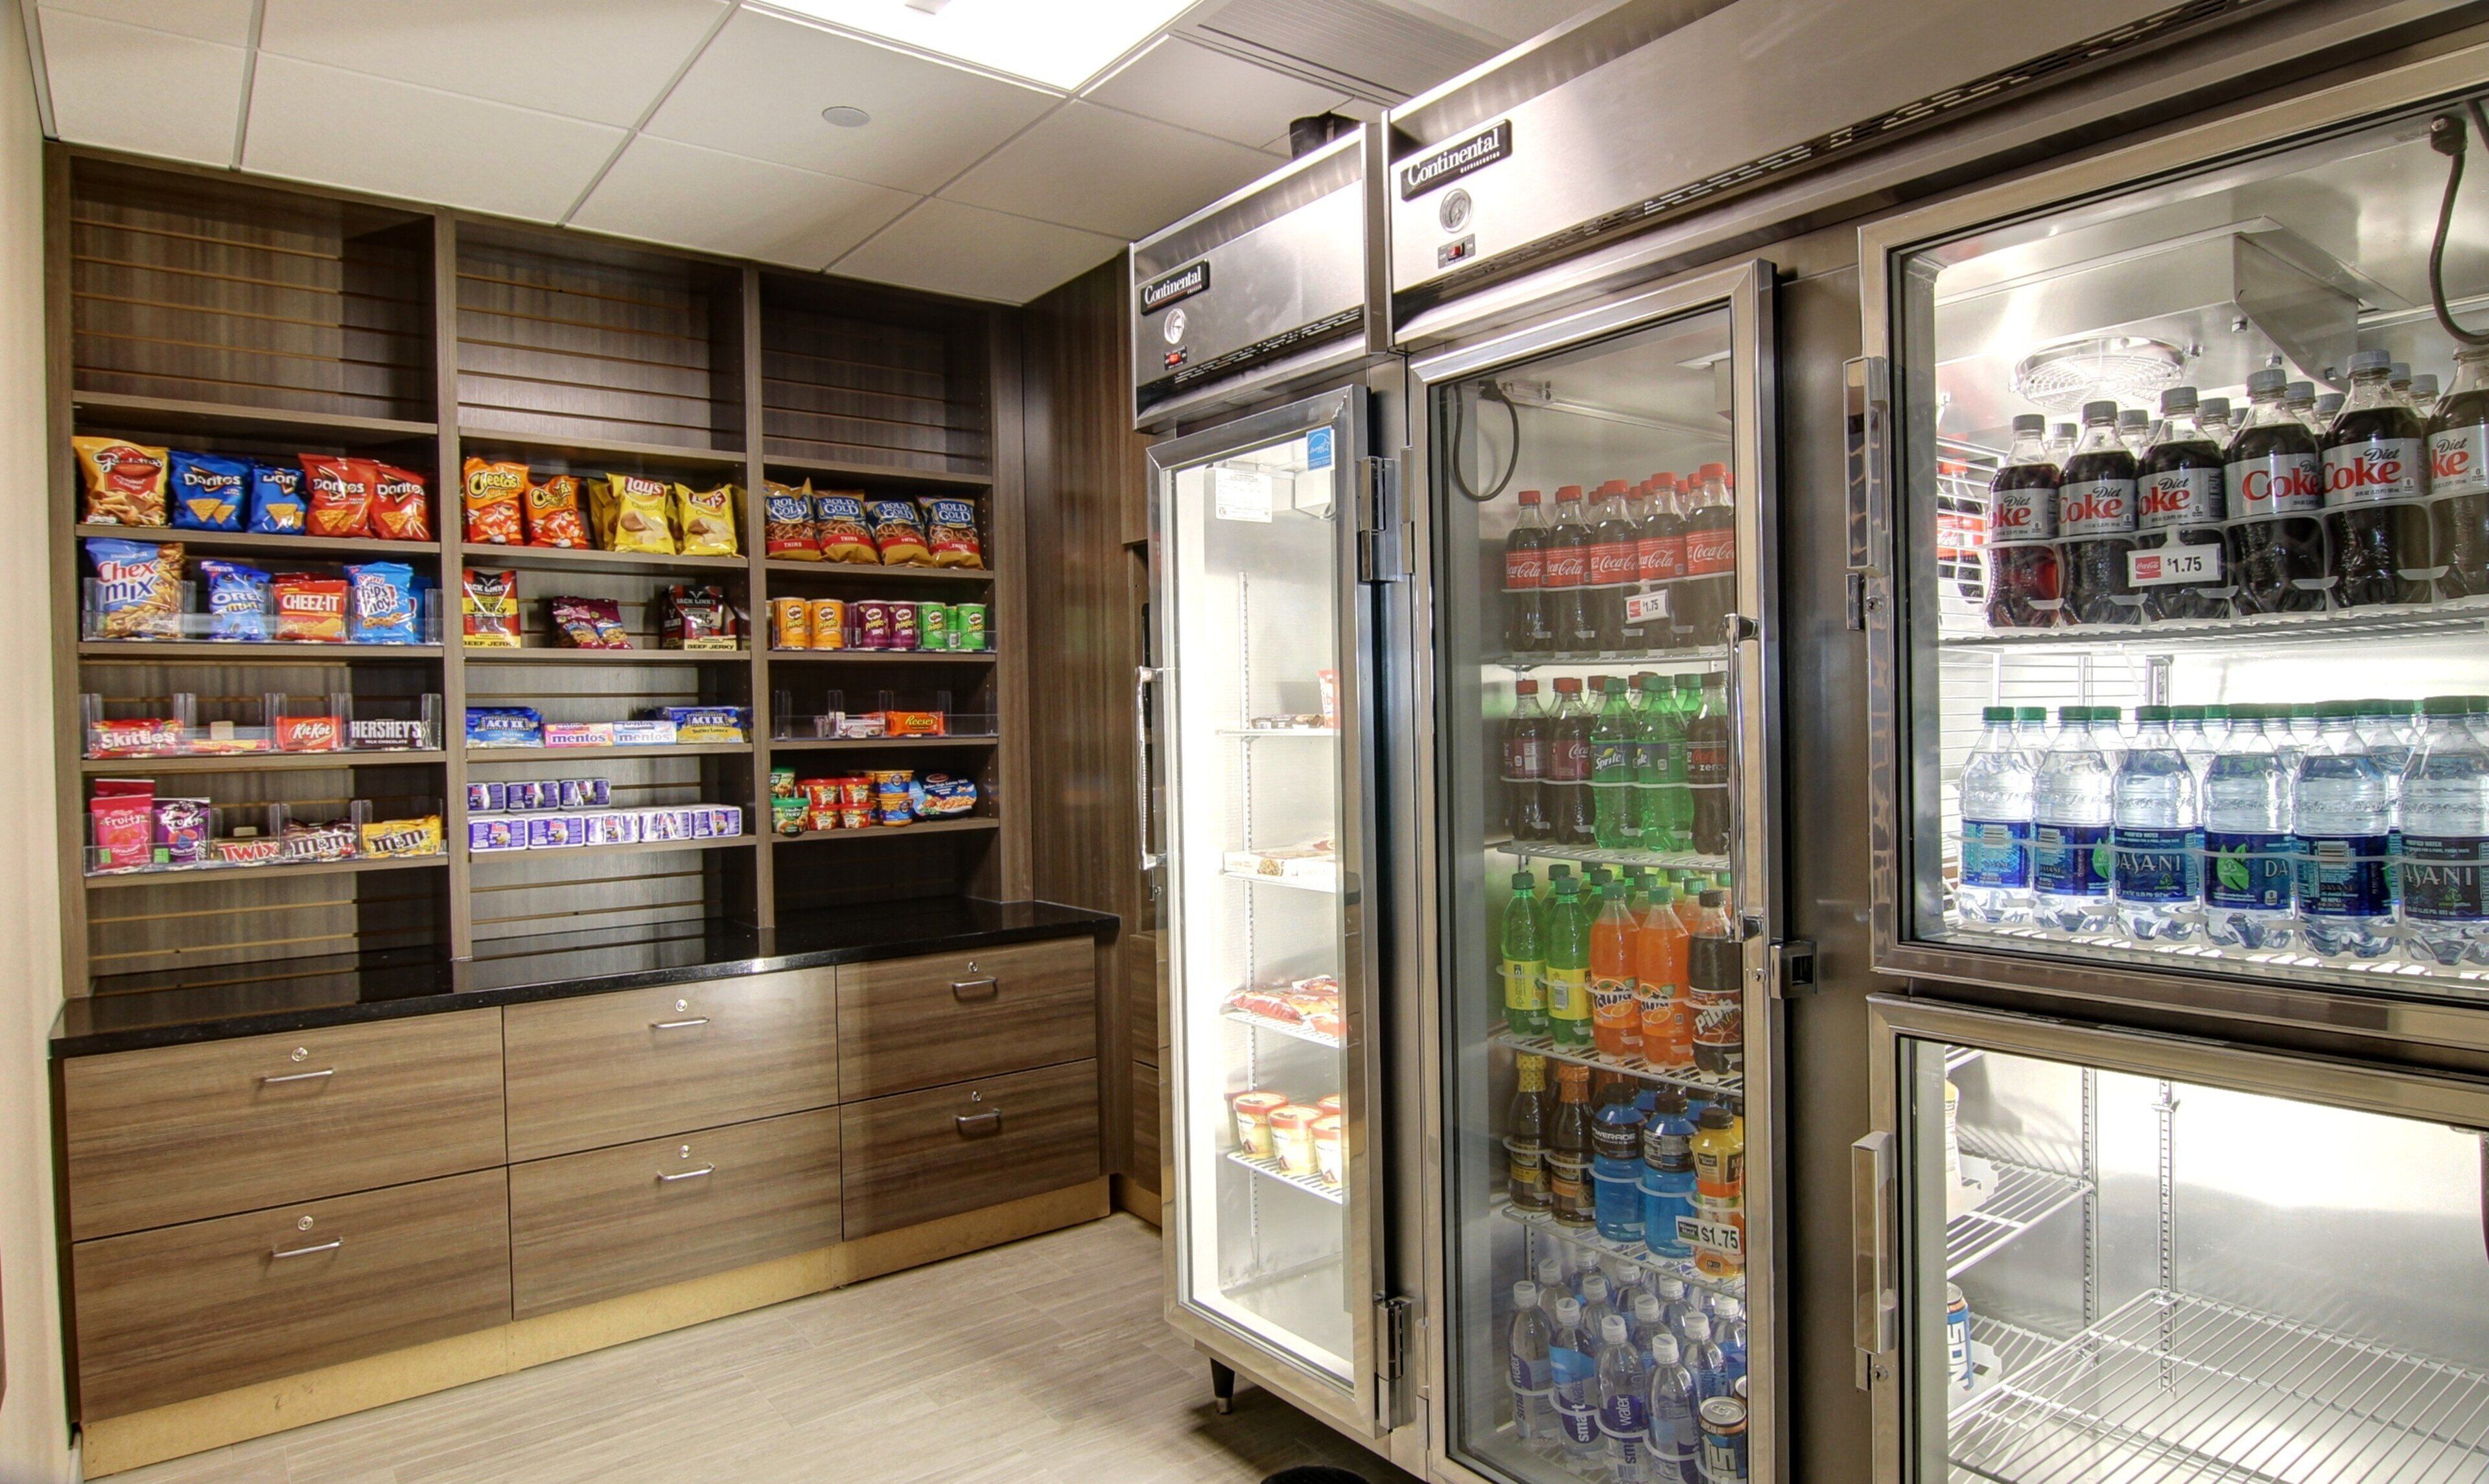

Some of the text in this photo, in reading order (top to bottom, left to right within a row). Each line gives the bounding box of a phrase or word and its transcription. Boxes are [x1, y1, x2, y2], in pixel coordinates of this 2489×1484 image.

[1408, 128, 1500, 186] Continental
[1144, 265, 1202, 305] Continental
[2436, 437, 2468, 454] Diet
[2363, 447, 2401, 461] Diet
[2432, 448, 2470, 480] ke
[183, 473, 243, 486] Doritos
[2323, 456, 2402, 494] Coke
[313, 479, 365, 494] Doritos
[377, 483, 425, 496] Doritos
[470, 471, 519, 496] Cheetos
[626, 476, 662, 495] Lay's
[2157, 477, 2190, 491] Diet
[2242, 467, 2322, 501] Coke
[2092, 486, 2123, 498] Diet
[773, 498, 804, 508] ROLD
[882, 502, 909, 511] ROLD
[940, 503, 968, 511] ROLD
[2004, 494, 2031, 507] Diet
[2059, 493, 2123, 524] Coke
[2139, 486, 2191, 516] oke
[772, 505, 807, 516] GOLD
[824, 504, 859, 515] GOLD
[883, 509, 914, 519] GOLD
[939, 511, 971, 522] GOLD
[1987, 503, 2032, 529] oke
[99, 561, 156, 583] Chex
[2167, 555, 2203, 573] $1.75
[283, 594, 340, 611] CHEEZ-IT
[1642, 599, 1659, 612] $1.75
[487, 719, 508, 728] ACT
[692, 716, 710, 725] ACT
[351, 721, 421, 739] HERSHEY'S
[619, 732, 671, 742] mentos
[101, 730, 176, 749] Skittles
[552, 734, 606, 743] mentos
[1595, 750, 1621, 771] Sprite
[2403, 864, 2472, 888] ASANI
[1592, 1128, 1635, 1141] OWERADE
[1701, 1226, 1738, 1249] $1.75
[1615, 1395, 1632, 1426] water
